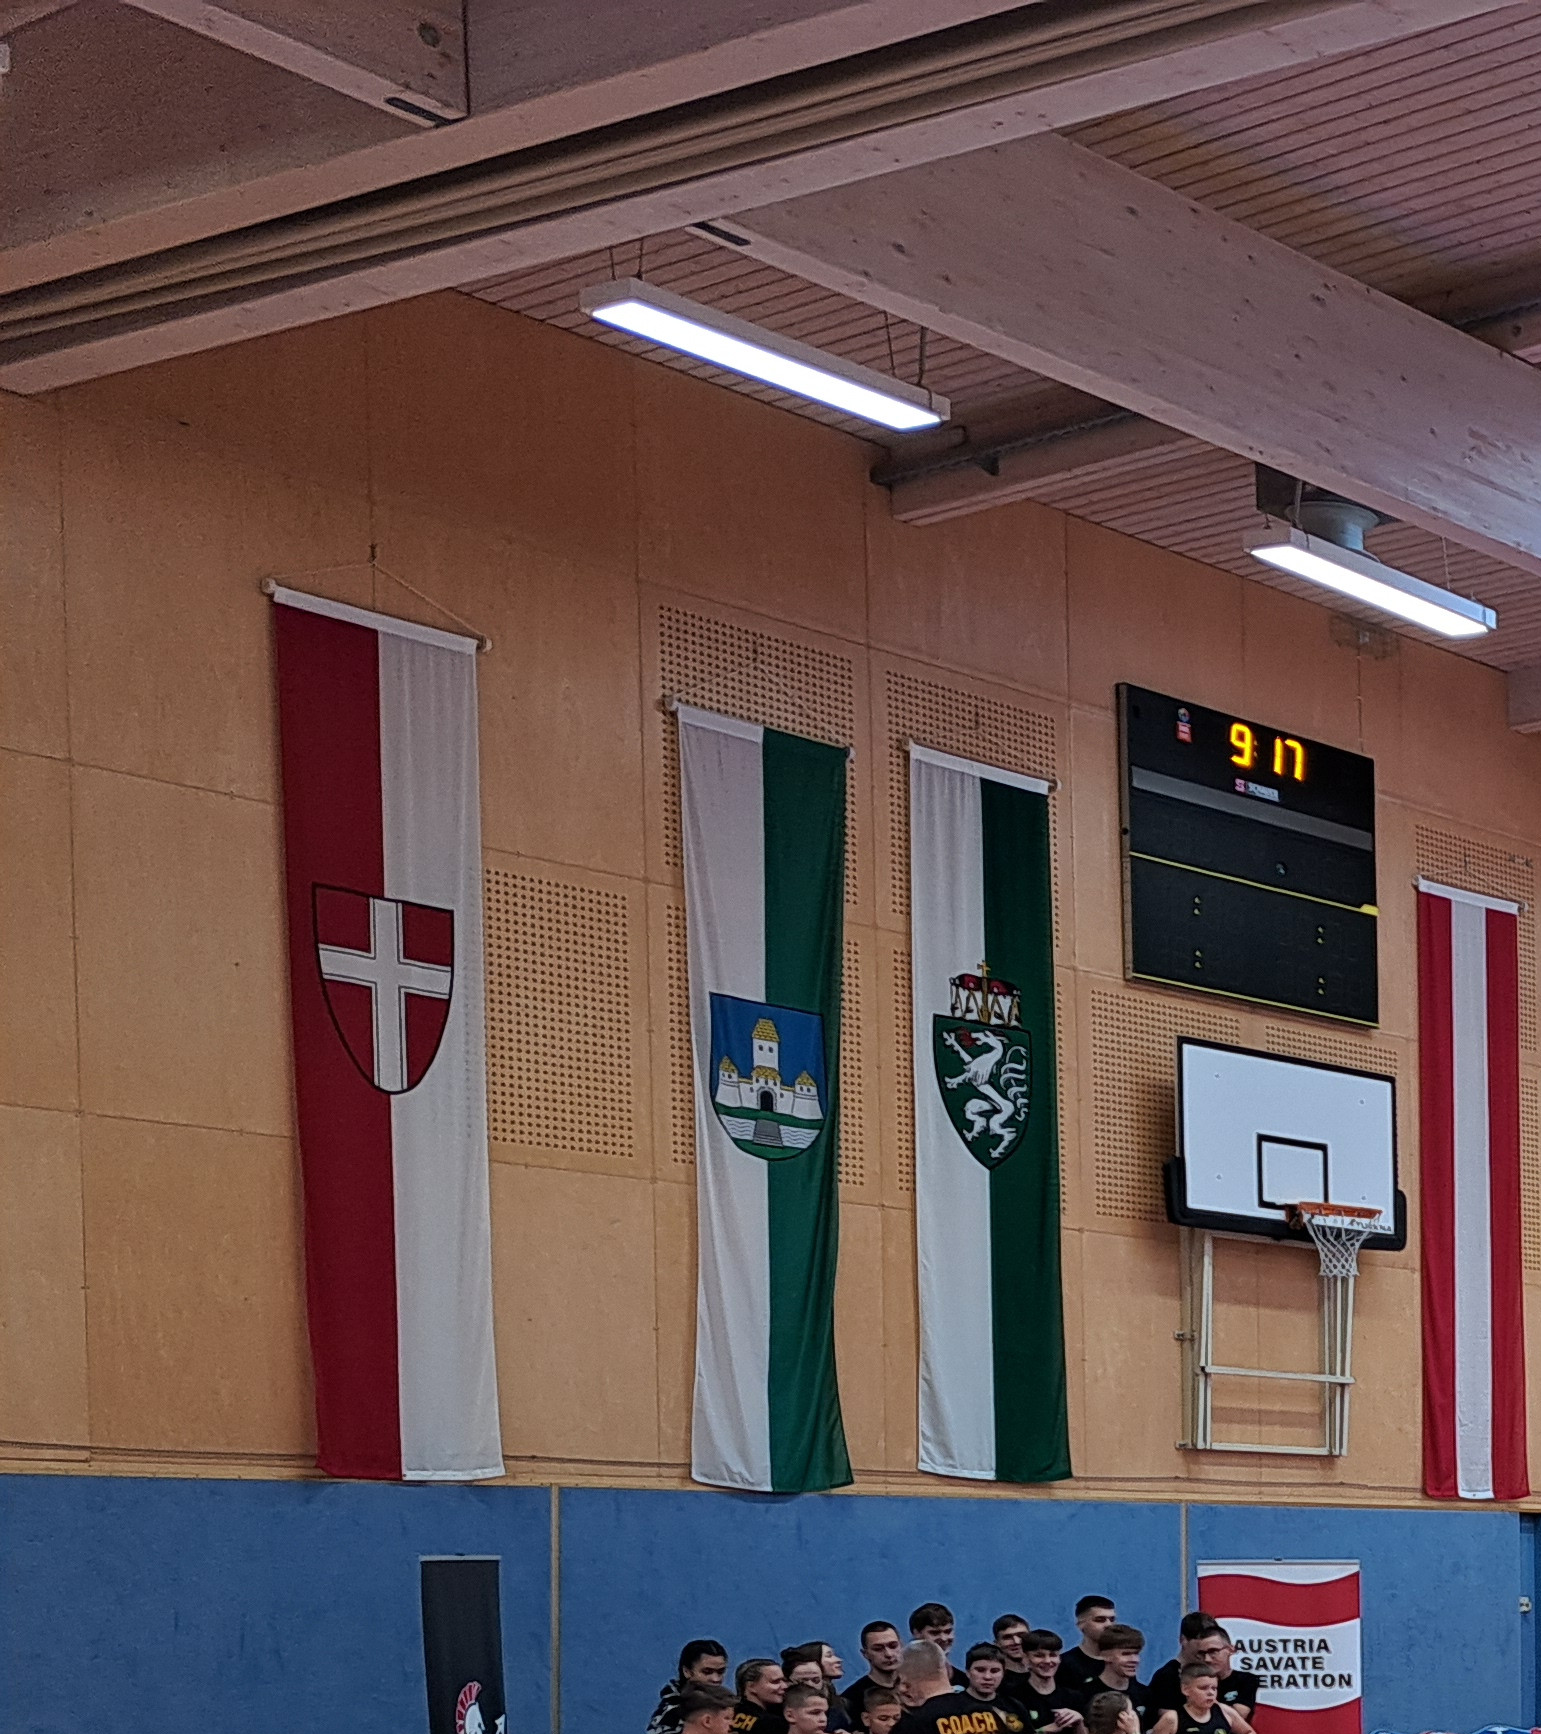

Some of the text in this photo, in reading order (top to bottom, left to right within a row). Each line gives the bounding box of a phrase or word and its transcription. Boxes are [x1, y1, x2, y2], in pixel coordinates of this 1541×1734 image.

[1233, 1638, 1332, 1655] AUSTRIA
[1239, 1655, 1326, 1671] SAVATE
[1257, 1672, 1353, 1689] ERATION
